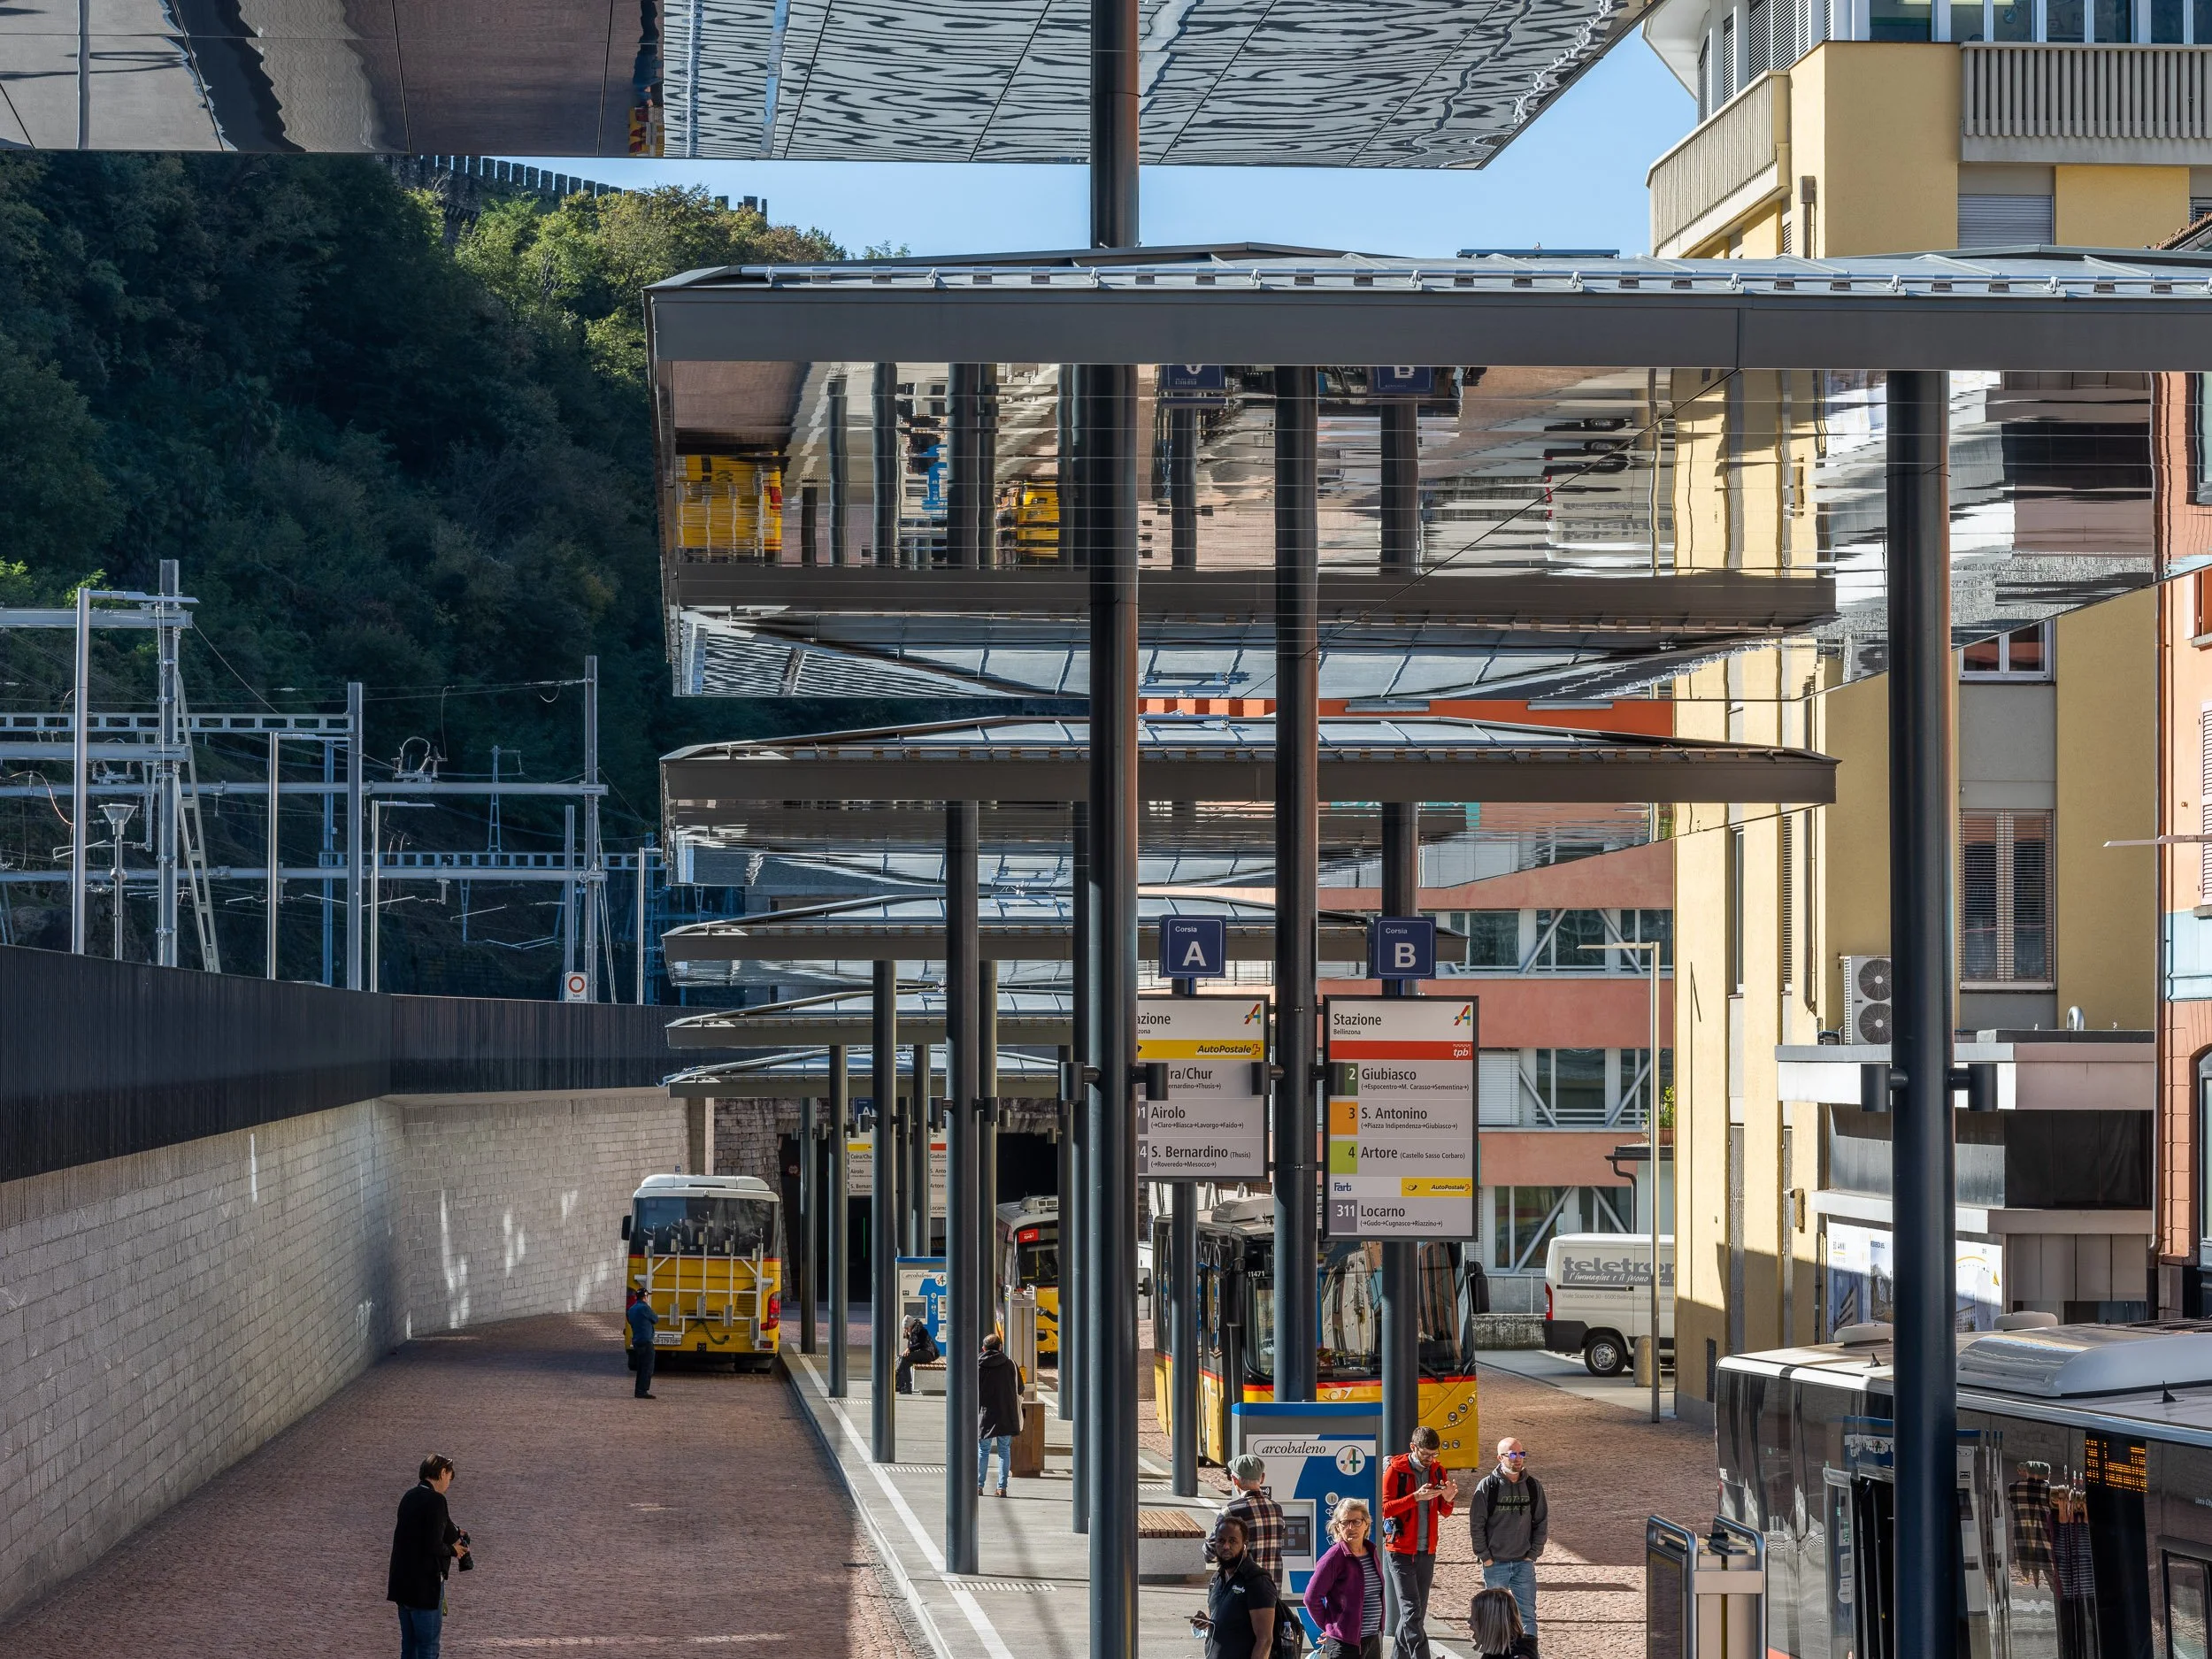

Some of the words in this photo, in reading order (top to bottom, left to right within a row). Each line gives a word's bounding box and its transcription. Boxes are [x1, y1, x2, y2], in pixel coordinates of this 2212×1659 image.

[1182, 941, 1207, 967] A
[1394, 942, 1417, 968] B
[1333, 1013, 1382, 1025] Stazione
[1453, 1048, 1469, 1058] tpb
[1169, 1067, 1213, 1079] ra/Chur
[1348, 1067, 1356, 1080] 2
[1362, 1067, 1417, 1080] Giubiasco
[1151, 1106, 1186, 1118] Airolo
[1348, 1107, 1356, 1119] 3
[1361, 1107, 1371, 1119] S.
[1375, 1107, 1427, 1119] Antonino
[1151, 1146, 1162, 1158] S.
[1165, 1145, 1228, 1158] Bernardino
[1348, 1147, 1356, 1158] 4
[1361, 1147, 1398, 1158] Artore
[1336, 1204, 1355, 1217] 311
[1361, 1205, 1405, 1217] Locarno
[1261, 1440, 1326, 1455] arcobaleno
